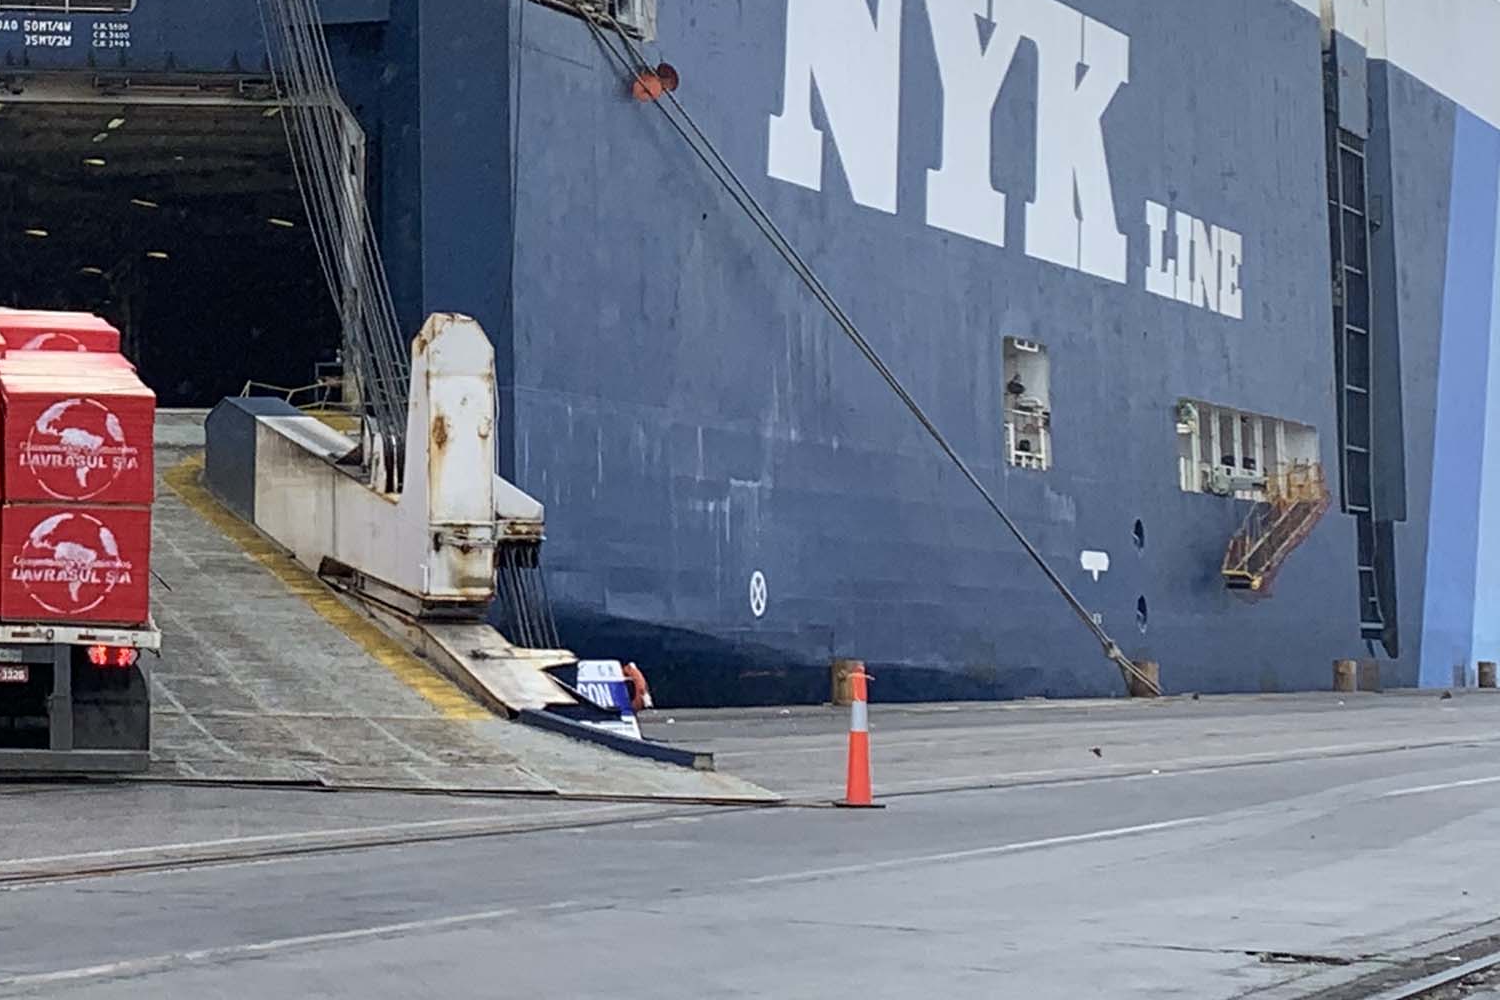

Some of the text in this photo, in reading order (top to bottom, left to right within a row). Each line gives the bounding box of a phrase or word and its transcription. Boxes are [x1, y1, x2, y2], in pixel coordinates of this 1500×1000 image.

[1145, 199, 1243, 319] LINE
[19, 453, 108, 469] LAVRASUL
[11, 568, 101, 584] LAVRASUL
